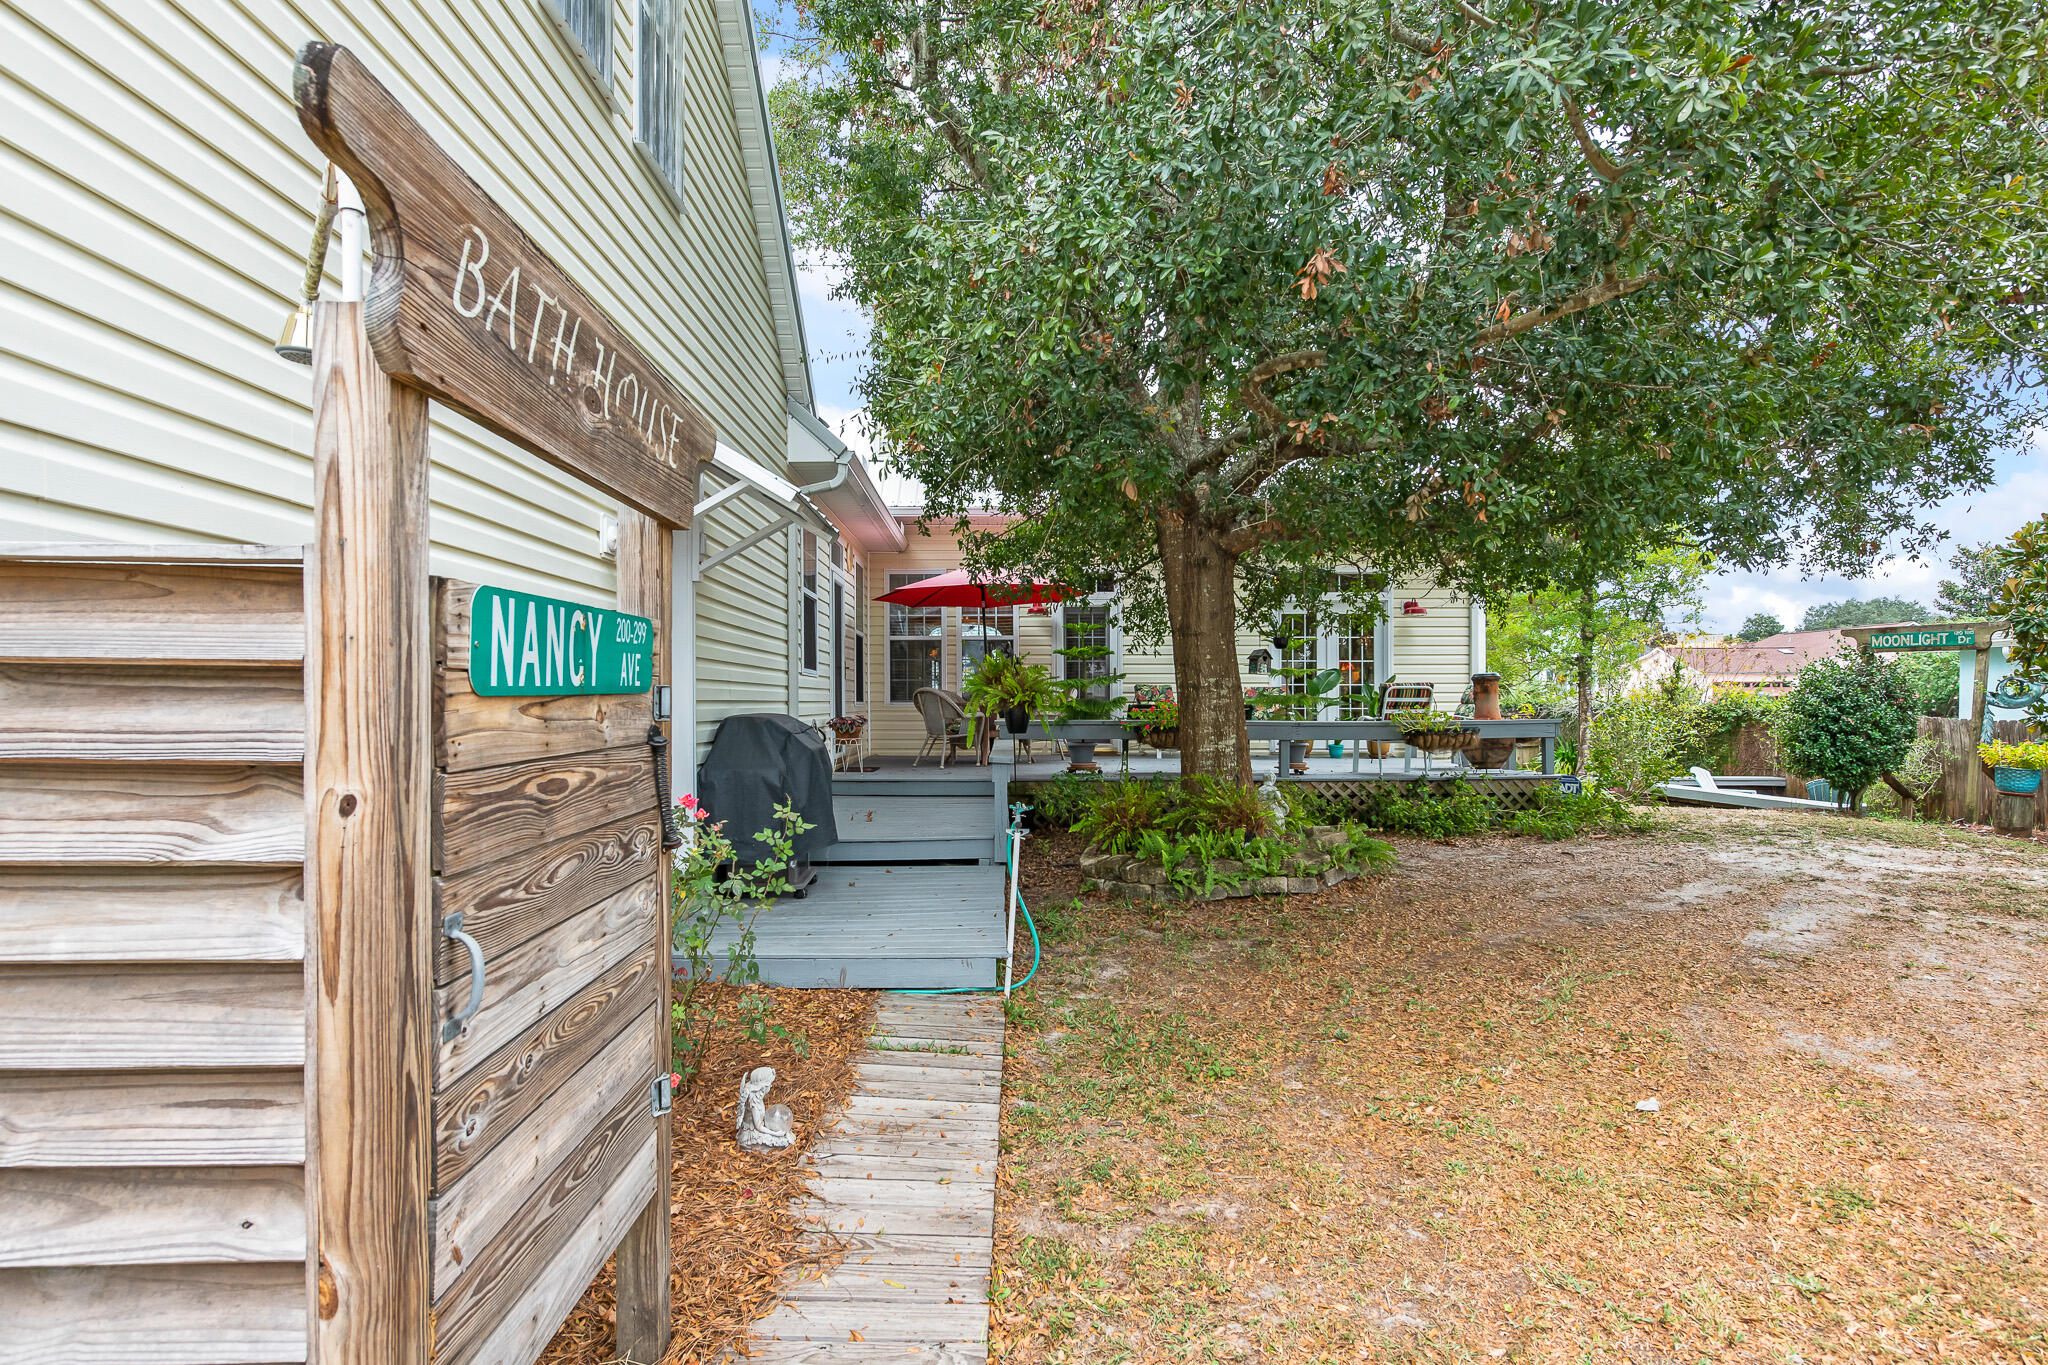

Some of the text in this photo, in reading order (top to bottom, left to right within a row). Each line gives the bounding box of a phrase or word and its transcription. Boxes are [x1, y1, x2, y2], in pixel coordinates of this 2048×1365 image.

[453, 223, 684, 468] BATH HOUSE
[490, 594, 641, 687] NANCY AVE
[616, 617, 648, 644] 200-299
[1871, 632, 1949, 647] MOONLIGHT
[1957, 635, 1972, 644] Dr
[1560, 783, 1579, 794] ADT
